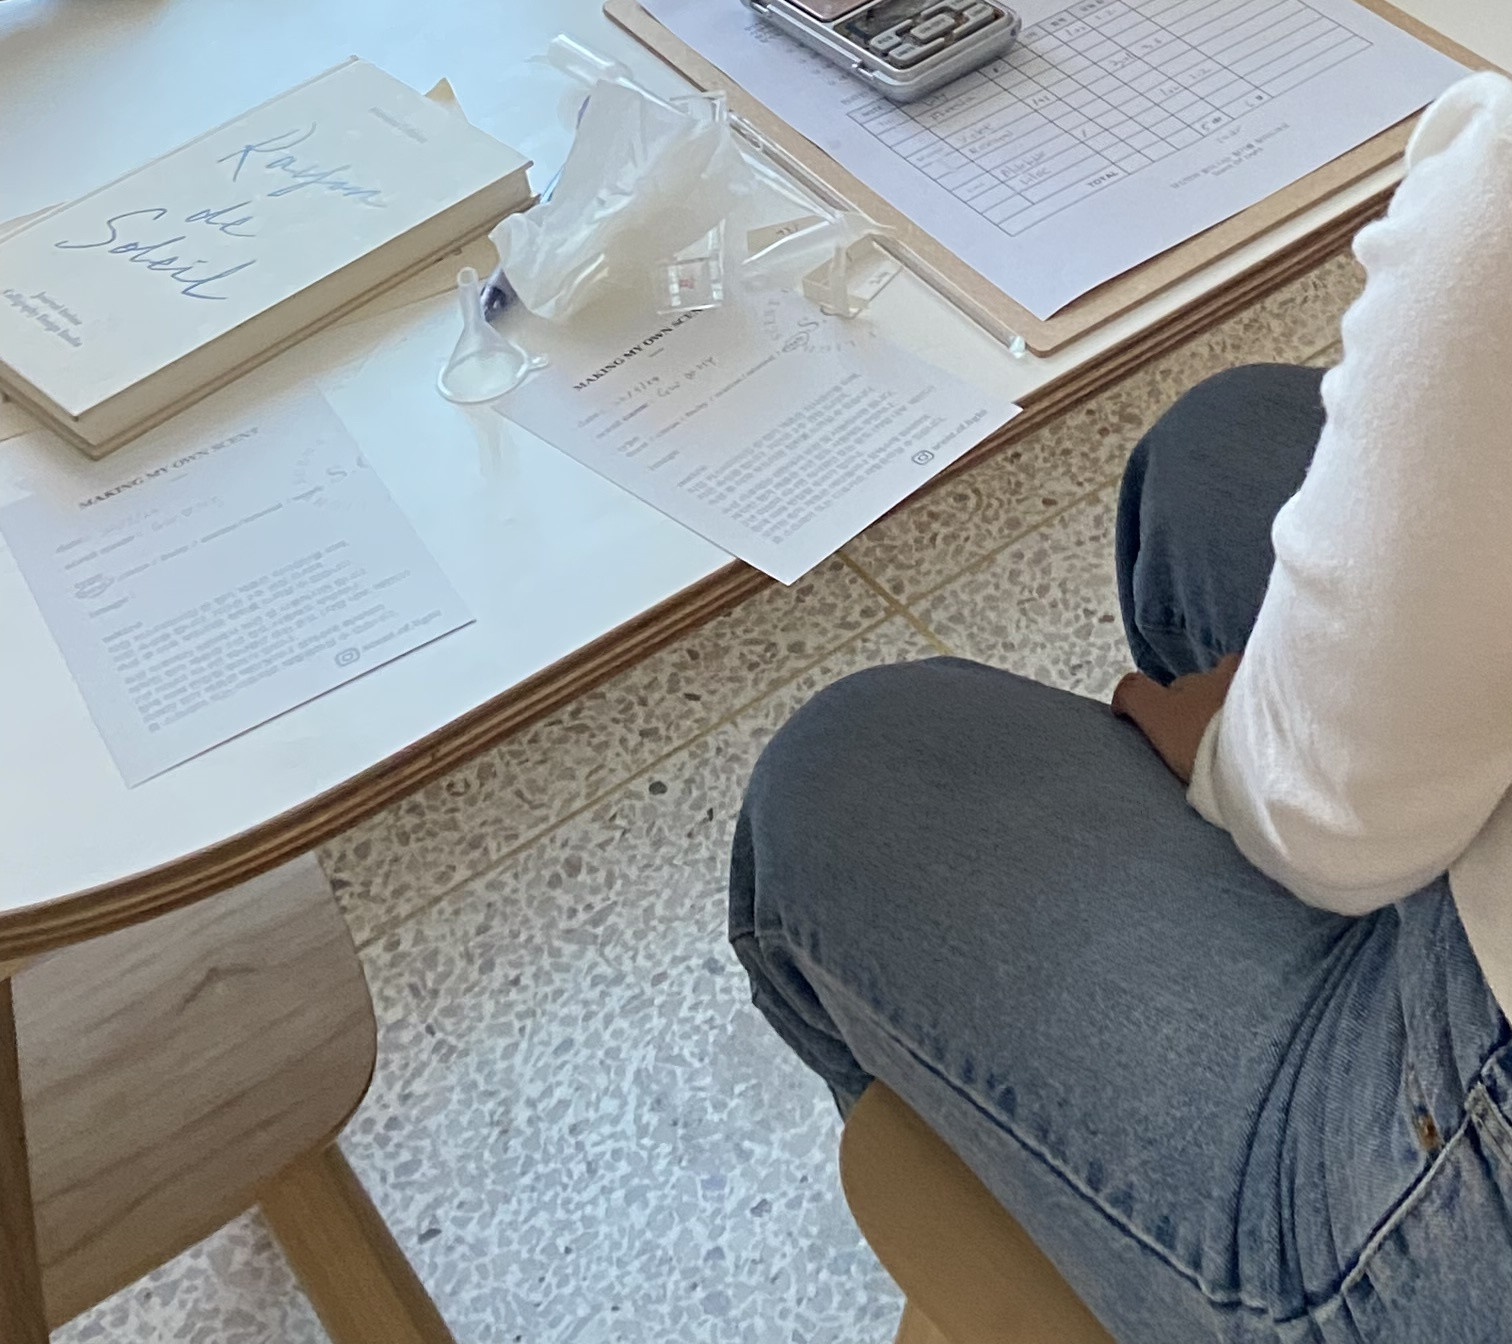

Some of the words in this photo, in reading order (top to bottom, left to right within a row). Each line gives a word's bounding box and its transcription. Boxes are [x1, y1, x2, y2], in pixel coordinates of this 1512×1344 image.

[1087, 169, 1120, 189] TOTAL
[184, 200, 257, 238] de
[53, 207, 258, 301] Soleil
[573, 356, 626, 392] MAKING
[622, 343, 644, 360] MY
[642, 326, 674, 347] OWN
[78, 477, 145, 509] MAKING
[145, 465, 169, 479] MY
[171, 447, 210, 469] OWN
[210, 425, 259, 451] SCENT
